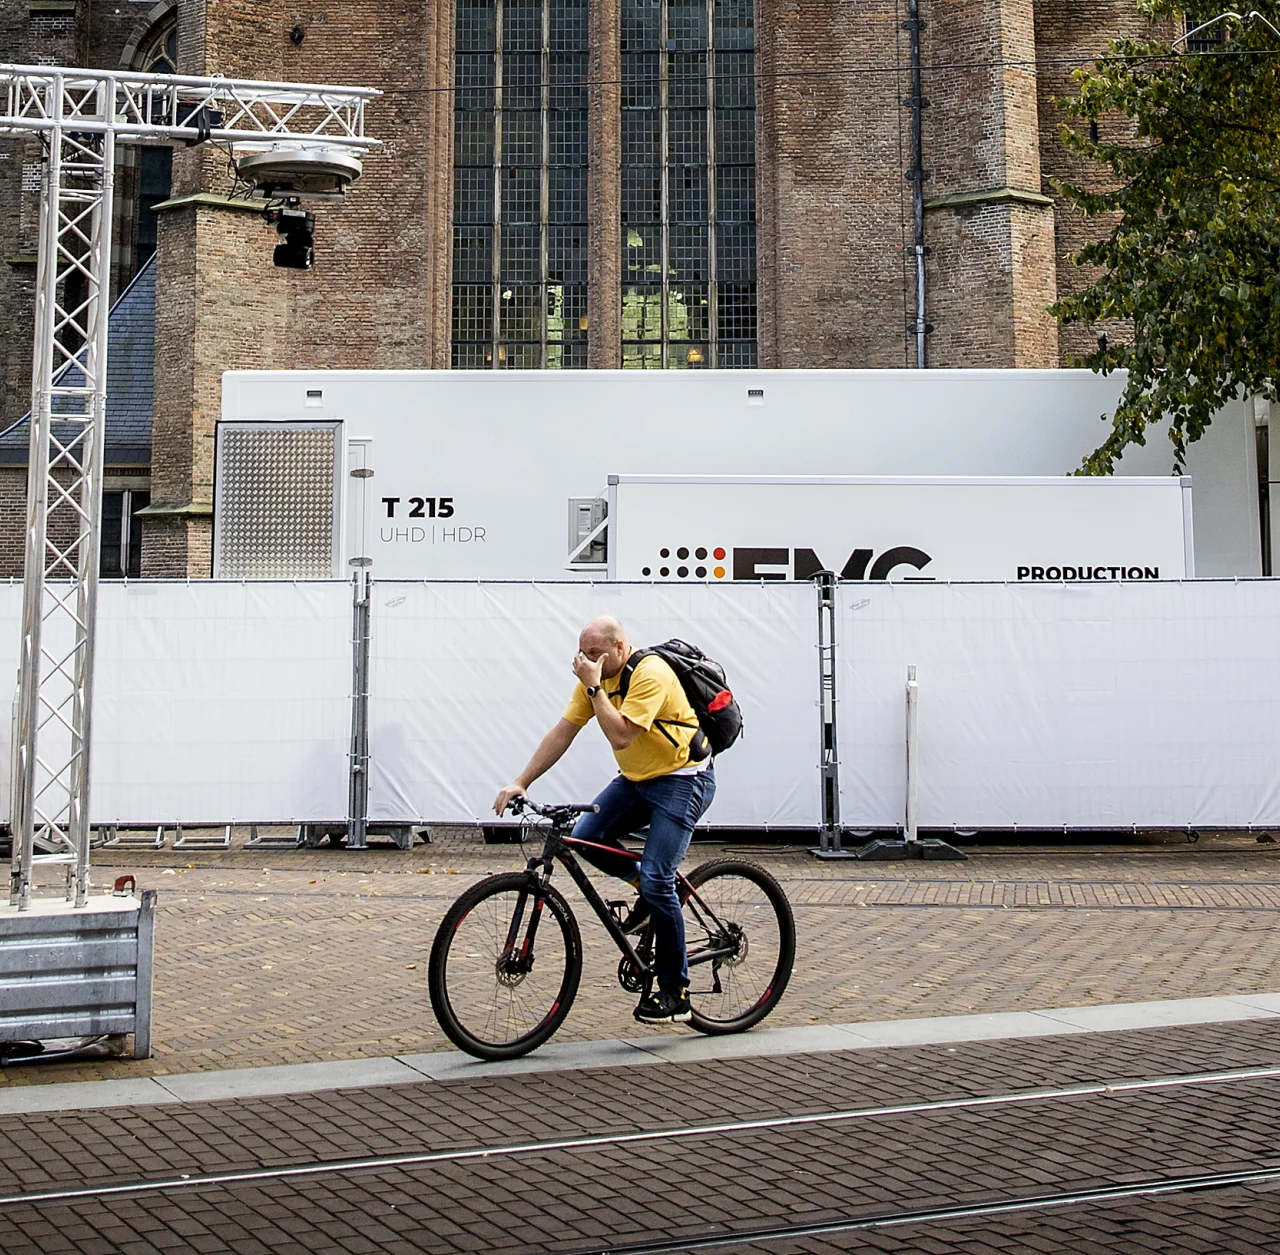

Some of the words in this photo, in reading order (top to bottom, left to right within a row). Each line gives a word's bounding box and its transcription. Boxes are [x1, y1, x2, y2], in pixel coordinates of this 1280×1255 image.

[381, 497, 400, 518] T
[408, 497, 454, 518] 215
[380, 527, 425, 542] UHD
[443, 527, 486, 542] HDR
[1017, 566, 1159, 580] PRODUCTION
